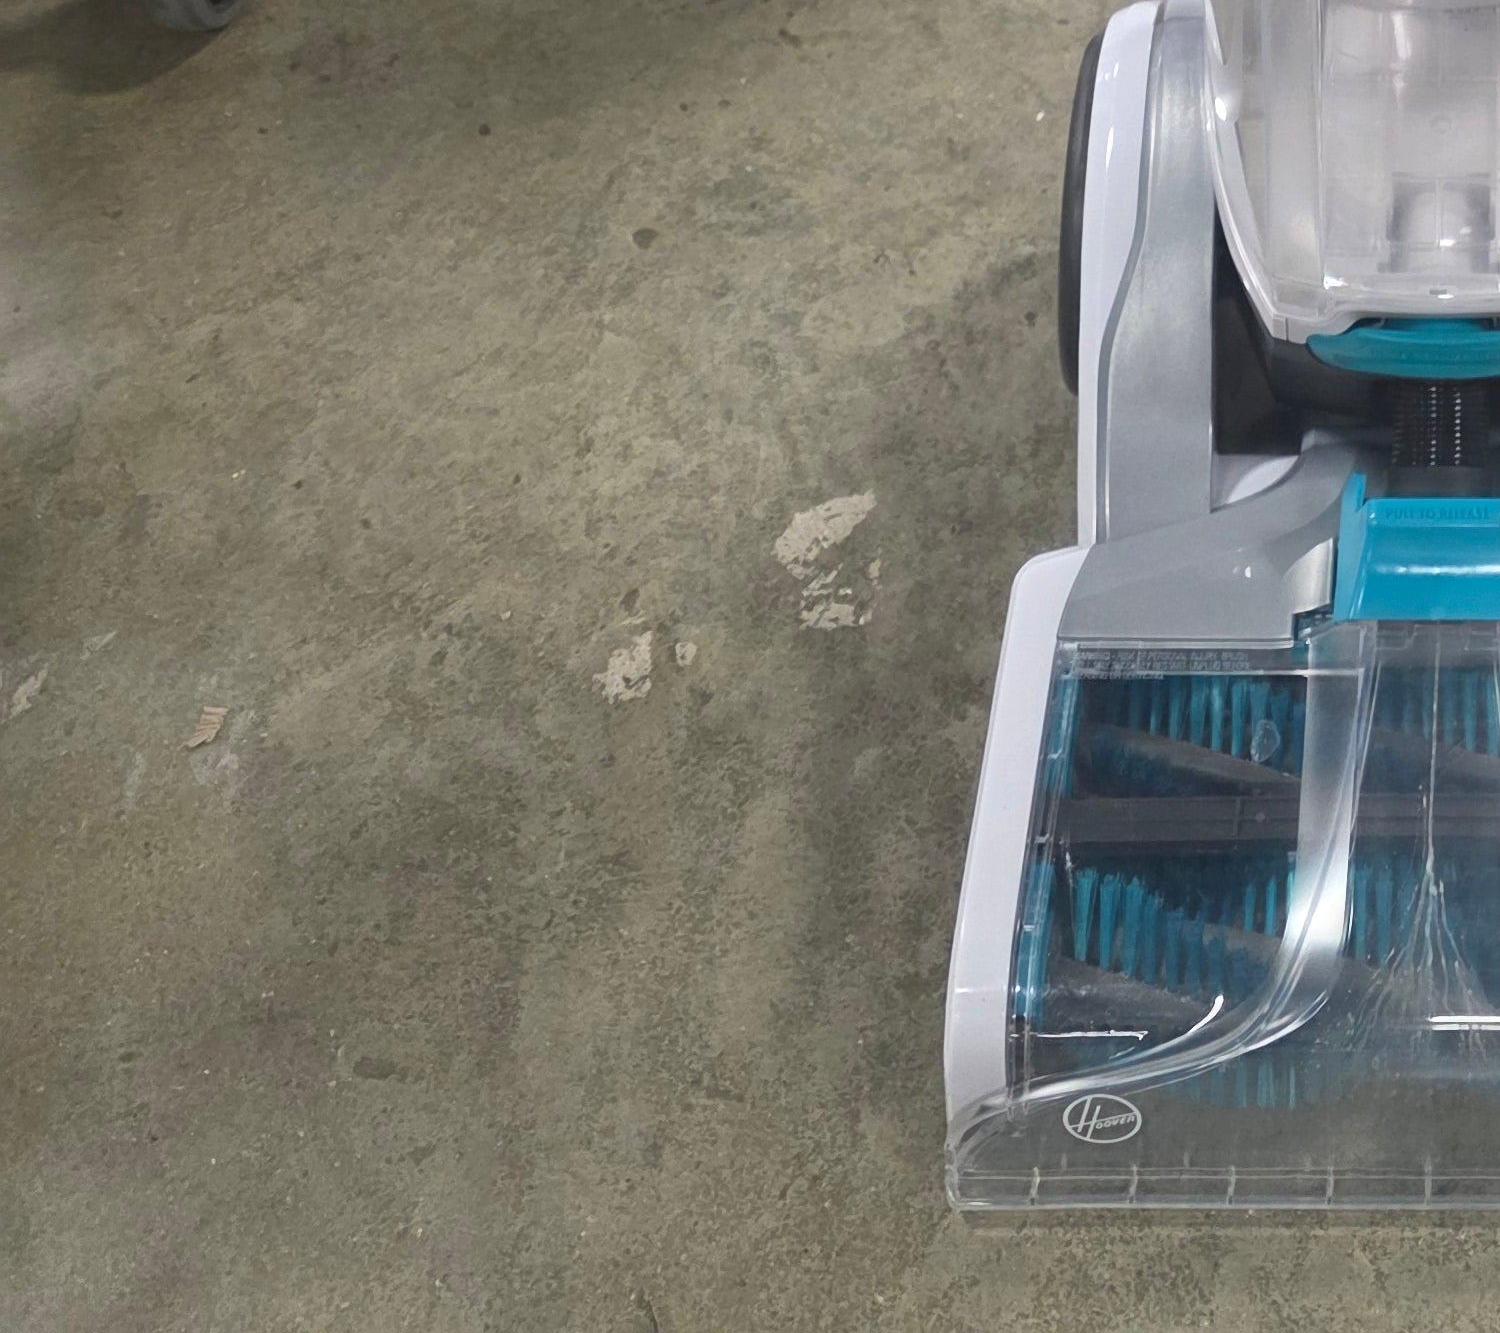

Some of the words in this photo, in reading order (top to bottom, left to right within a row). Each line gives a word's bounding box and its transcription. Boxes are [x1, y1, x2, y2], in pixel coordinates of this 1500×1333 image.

[1386, 507, 1414, 520] PULL
[1419, 507, 1437, 520] TO
[1438, 506, 1490, 520] RELEASE
[1068, 1096, 1138, 1141] HOOVER
